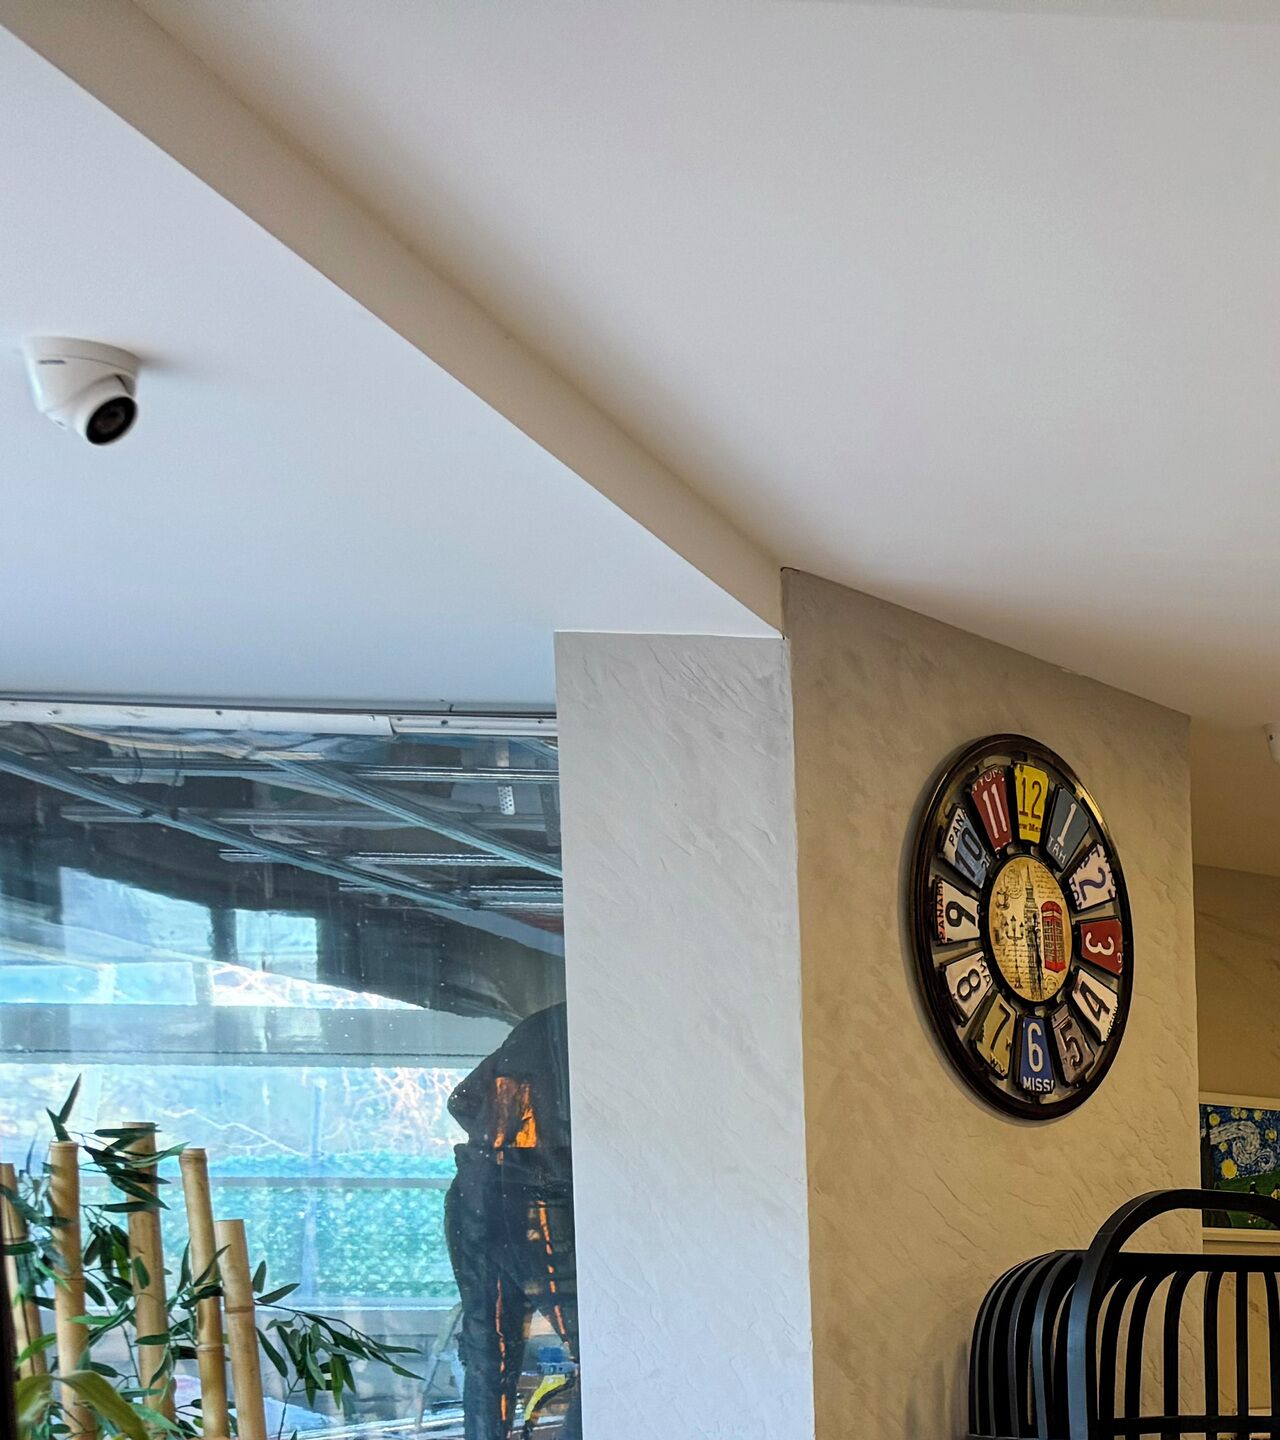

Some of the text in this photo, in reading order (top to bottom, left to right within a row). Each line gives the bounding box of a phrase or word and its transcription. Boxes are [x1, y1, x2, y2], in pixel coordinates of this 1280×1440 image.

[982, 783, 1007, 839] 11
[1019, 777, 1042, 819] 12
[1057, 802, 1077, 847] 1
[955, 827, 982, 879] 10
[1079, 867, 1106, 902] 2
[945, 901, 976, 927] 9
[1085, 932, 1114, 956] 3
[957, 968, 981, 1002] 8
[1080, 981, 1110, 1021] 4
[990, 1002, 1010, 1050] 7
[1027, 1022, 1044, 1073] 6
[1060, 1016, 1083, 1067] 5
